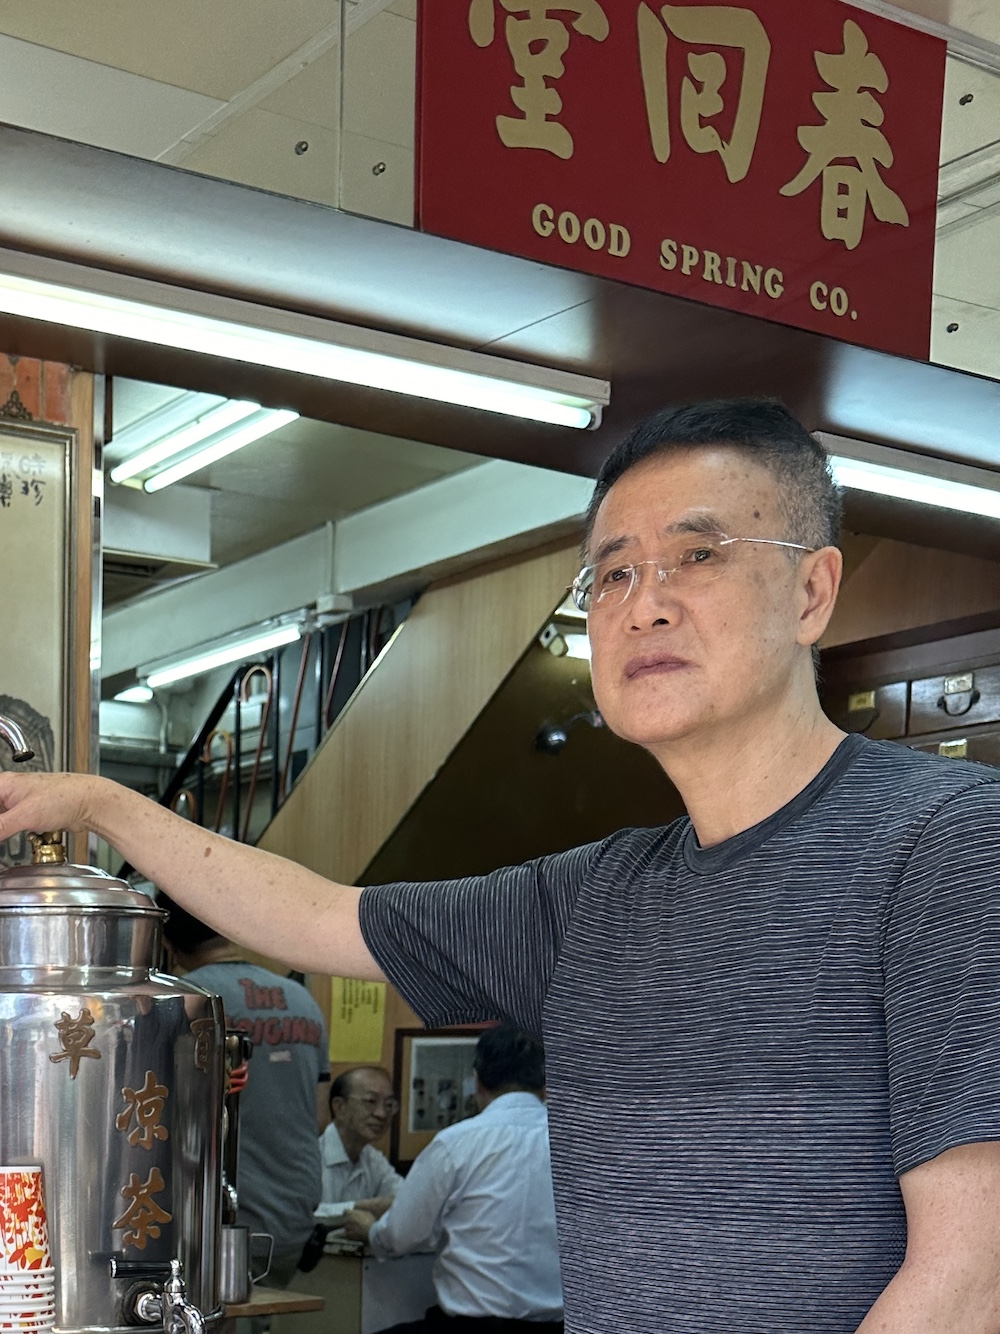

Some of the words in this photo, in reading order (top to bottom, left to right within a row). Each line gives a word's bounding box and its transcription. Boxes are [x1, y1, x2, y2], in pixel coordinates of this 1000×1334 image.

[531, 203, 631, 259] GOOD
[659, 238, 785, 300] SPRING
[809, 280, 858, 321] CO.
